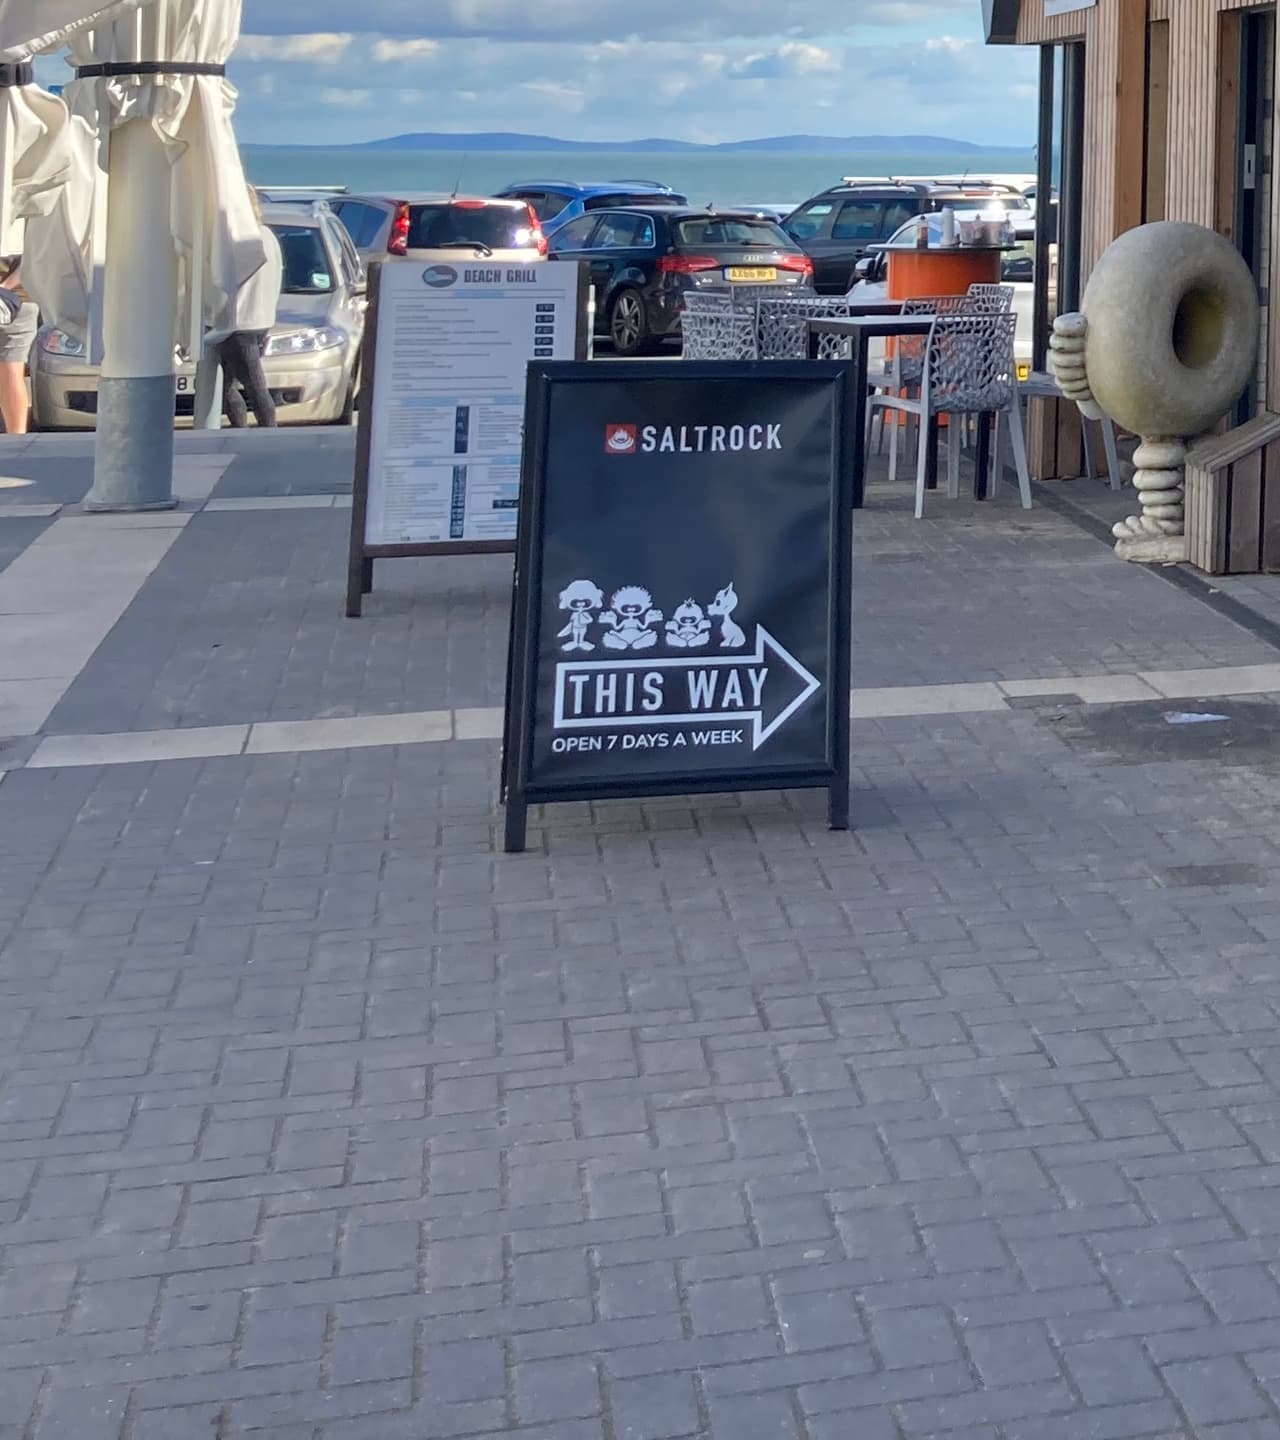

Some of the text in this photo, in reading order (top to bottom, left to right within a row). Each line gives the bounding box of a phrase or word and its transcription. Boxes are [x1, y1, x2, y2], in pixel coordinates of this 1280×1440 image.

[464, 269, 537, 284] BEACH GRILL
[641, 423, 782, 452] SALTROCK
[569, 667, 768, 714] THIS WAY
[551, 729, 744, 752] OPEN 7 DAYS A WEEK
